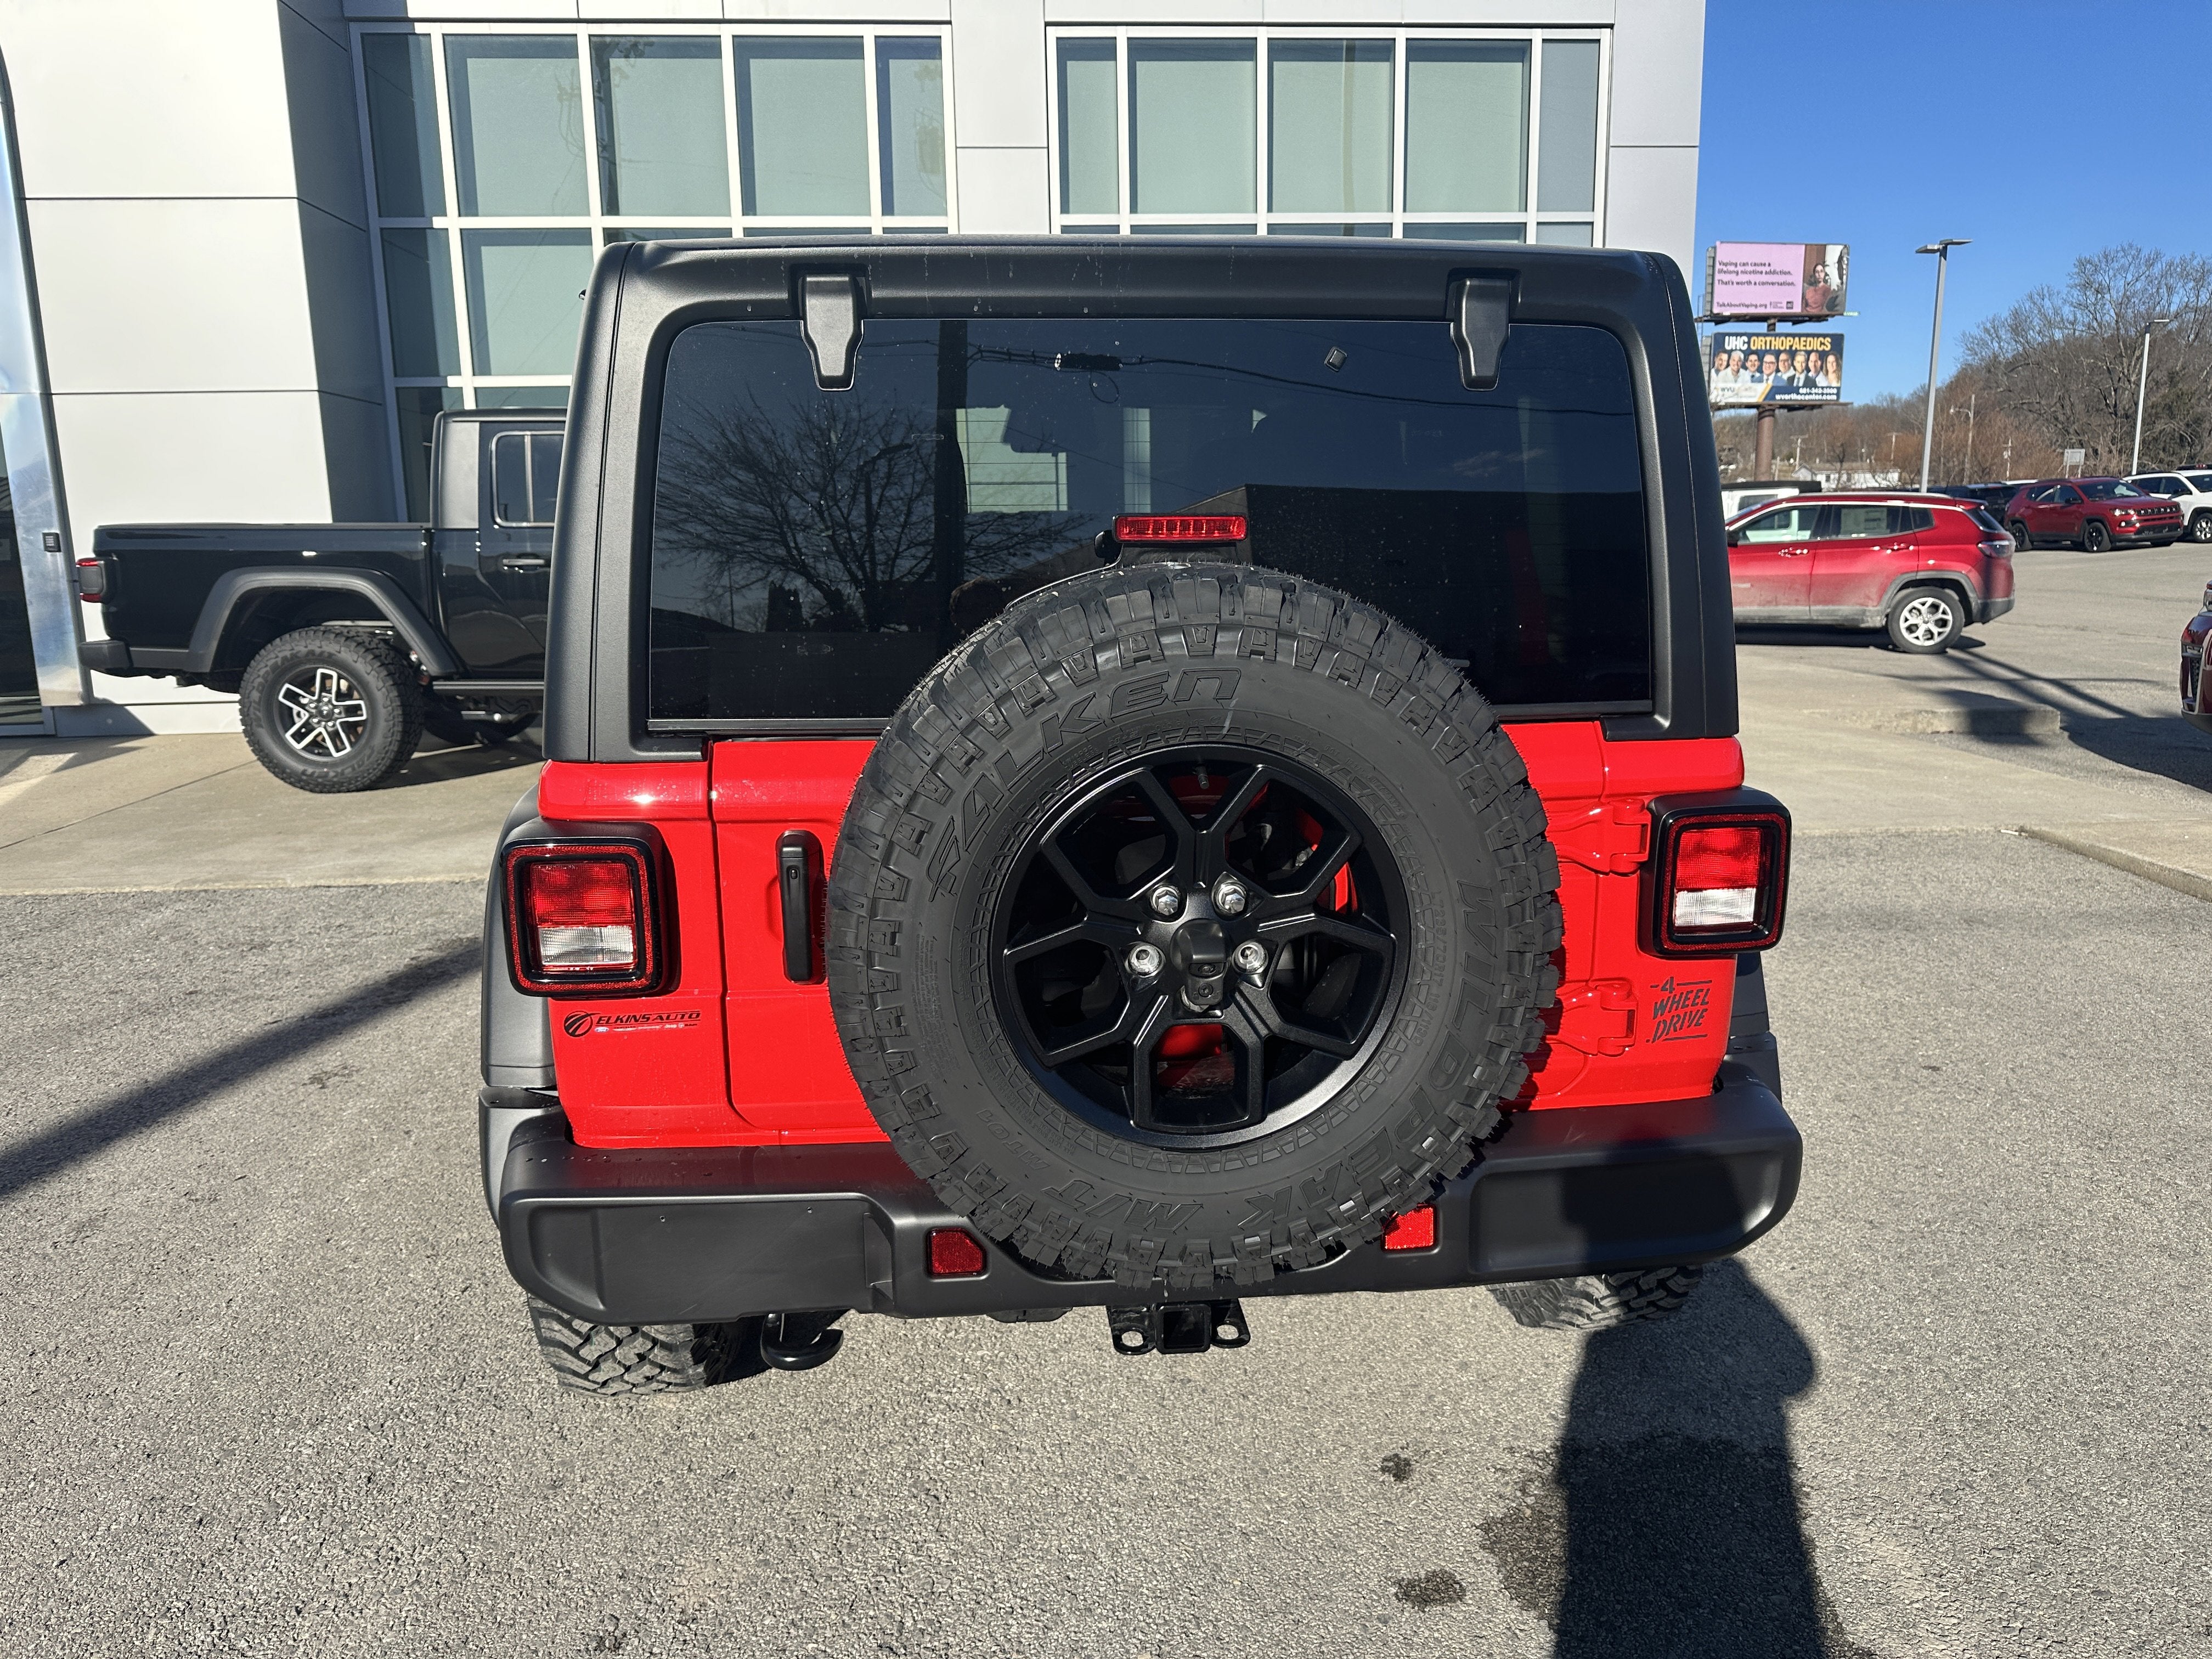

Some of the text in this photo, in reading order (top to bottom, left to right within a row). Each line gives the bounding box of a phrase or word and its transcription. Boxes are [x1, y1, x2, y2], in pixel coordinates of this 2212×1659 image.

[1725, 335, 1831, 351] UHC ORTHOPAEDICS
[926, 667, 1242, 902] FALKEN
[1660, 976, 1675, 994] 4
[1652, 988, 1711, 1020] WHEEL
[1651, 1008, 1708, 1044] DRIVE
